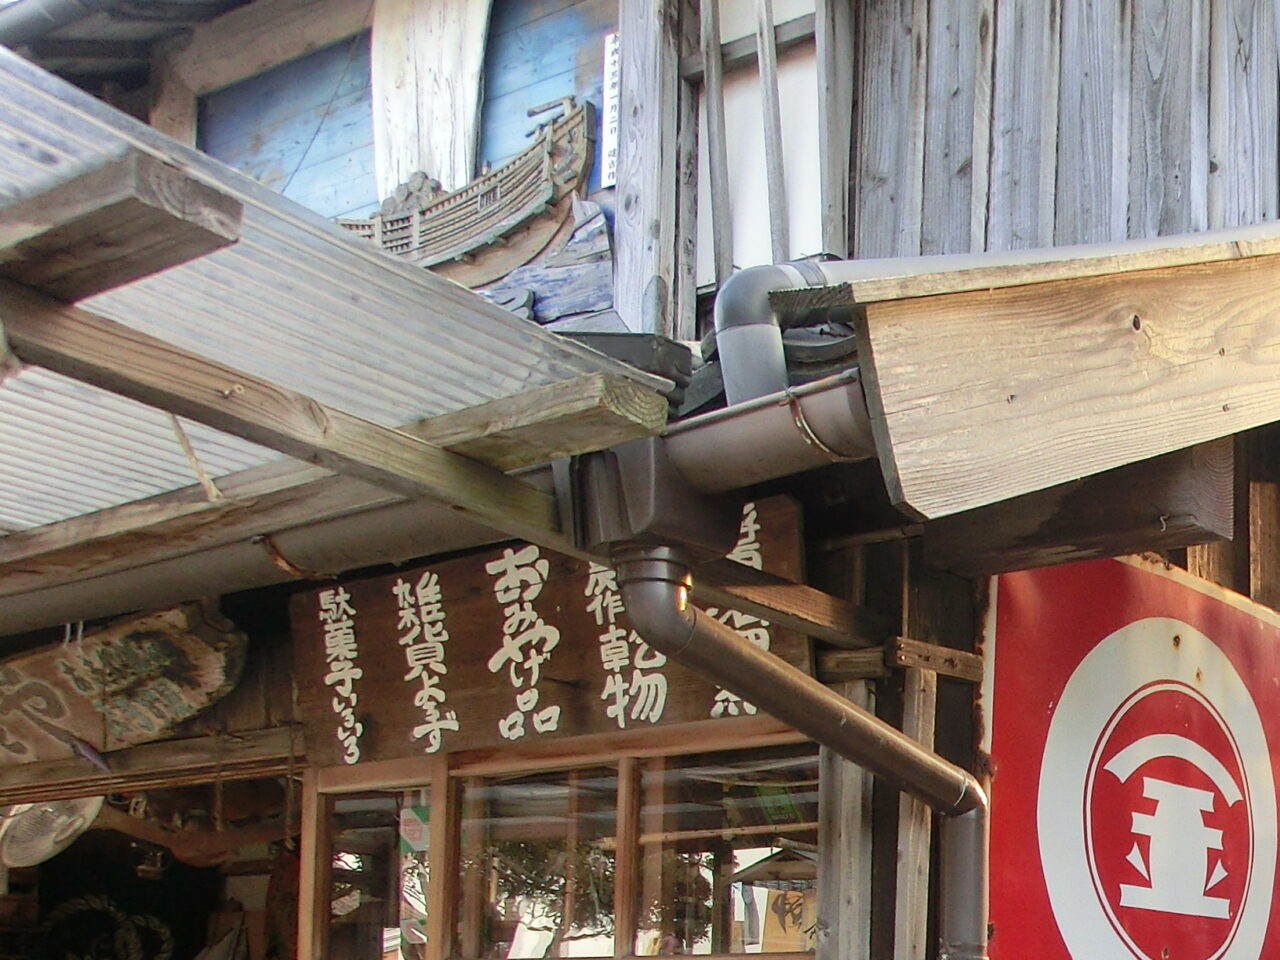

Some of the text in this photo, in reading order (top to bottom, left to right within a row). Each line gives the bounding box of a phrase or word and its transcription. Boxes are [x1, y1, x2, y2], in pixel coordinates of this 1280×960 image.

[318, 587, 363, 765] 駄菓子いろいろ
[392, 571, 460, 754] 雑貨よろず
[486, 545, 561, 740] おみやげ品
